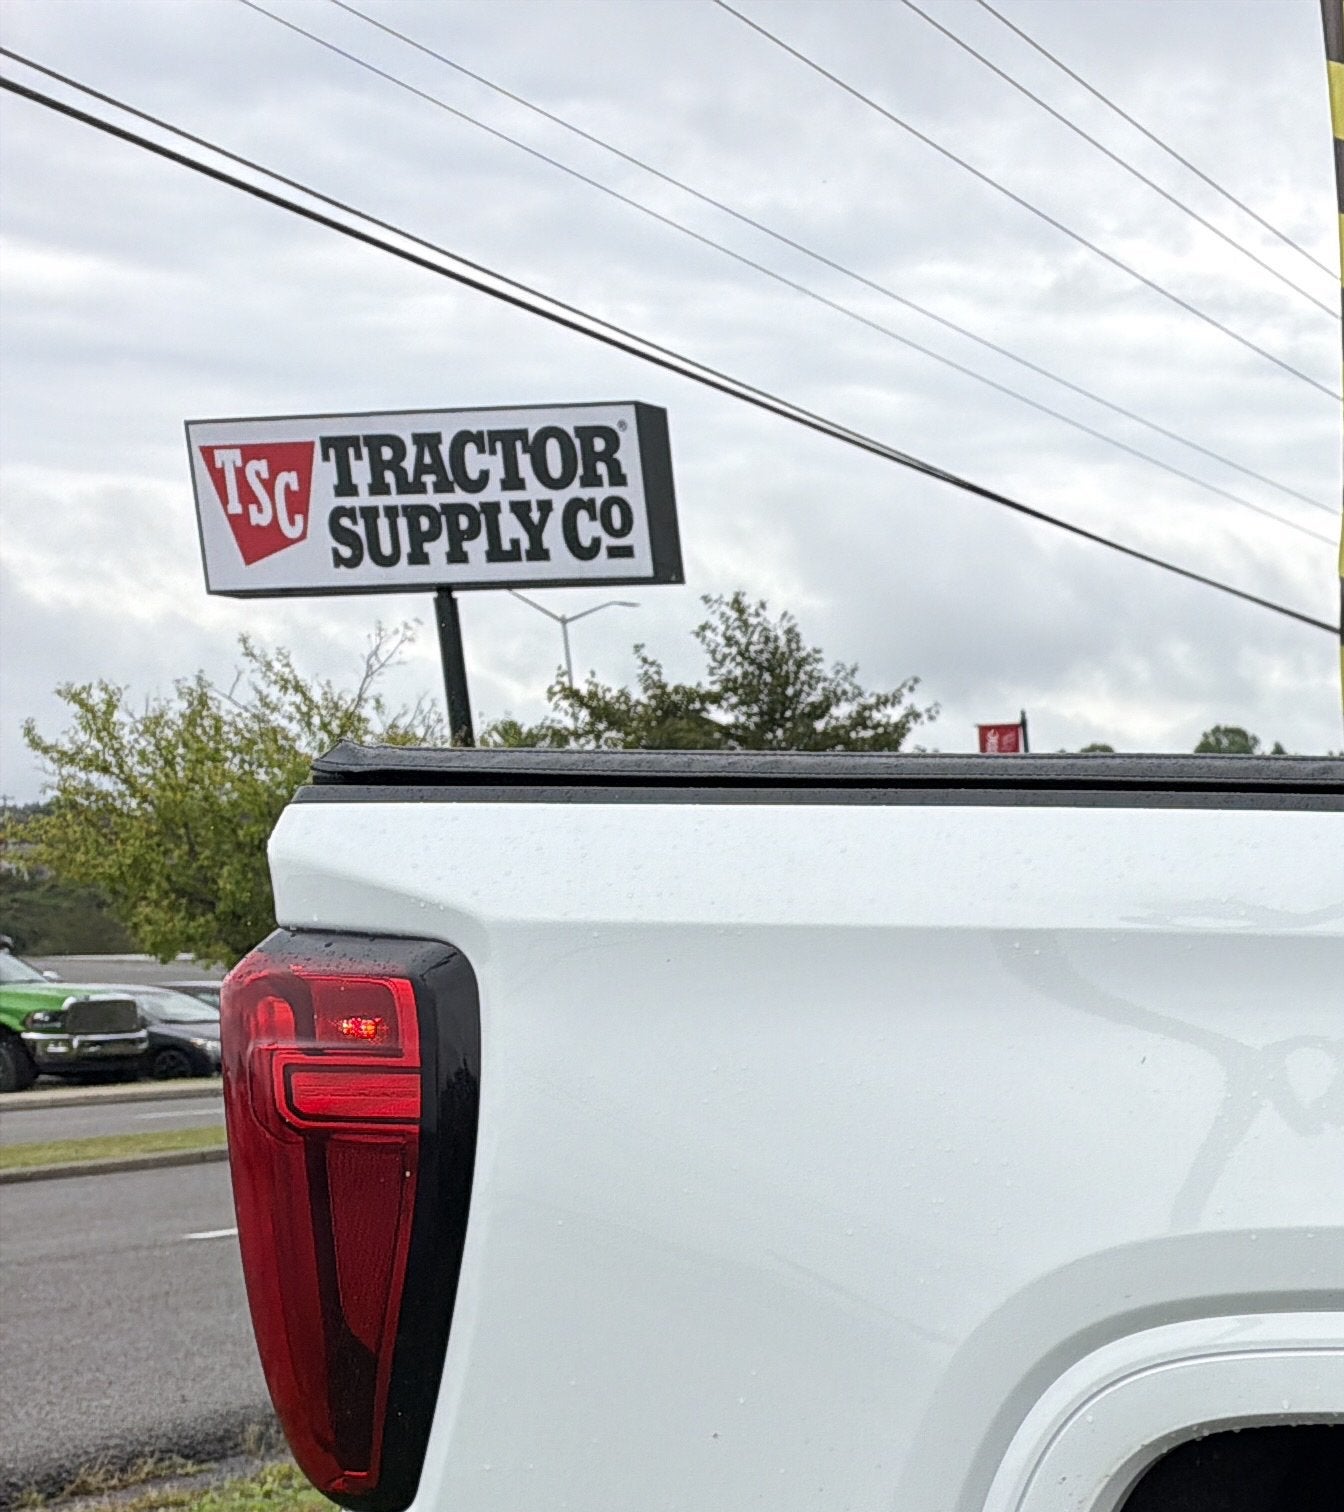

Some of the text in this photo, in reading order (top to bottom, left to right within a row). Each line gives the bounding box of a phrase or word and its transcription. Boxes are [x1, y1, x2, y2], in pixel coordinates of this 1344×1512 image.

[214, 447, 304, 540] TSC
[319, 424, 628, 498] TRACTOR
[327, 497, 553, 569] SUPPLY
